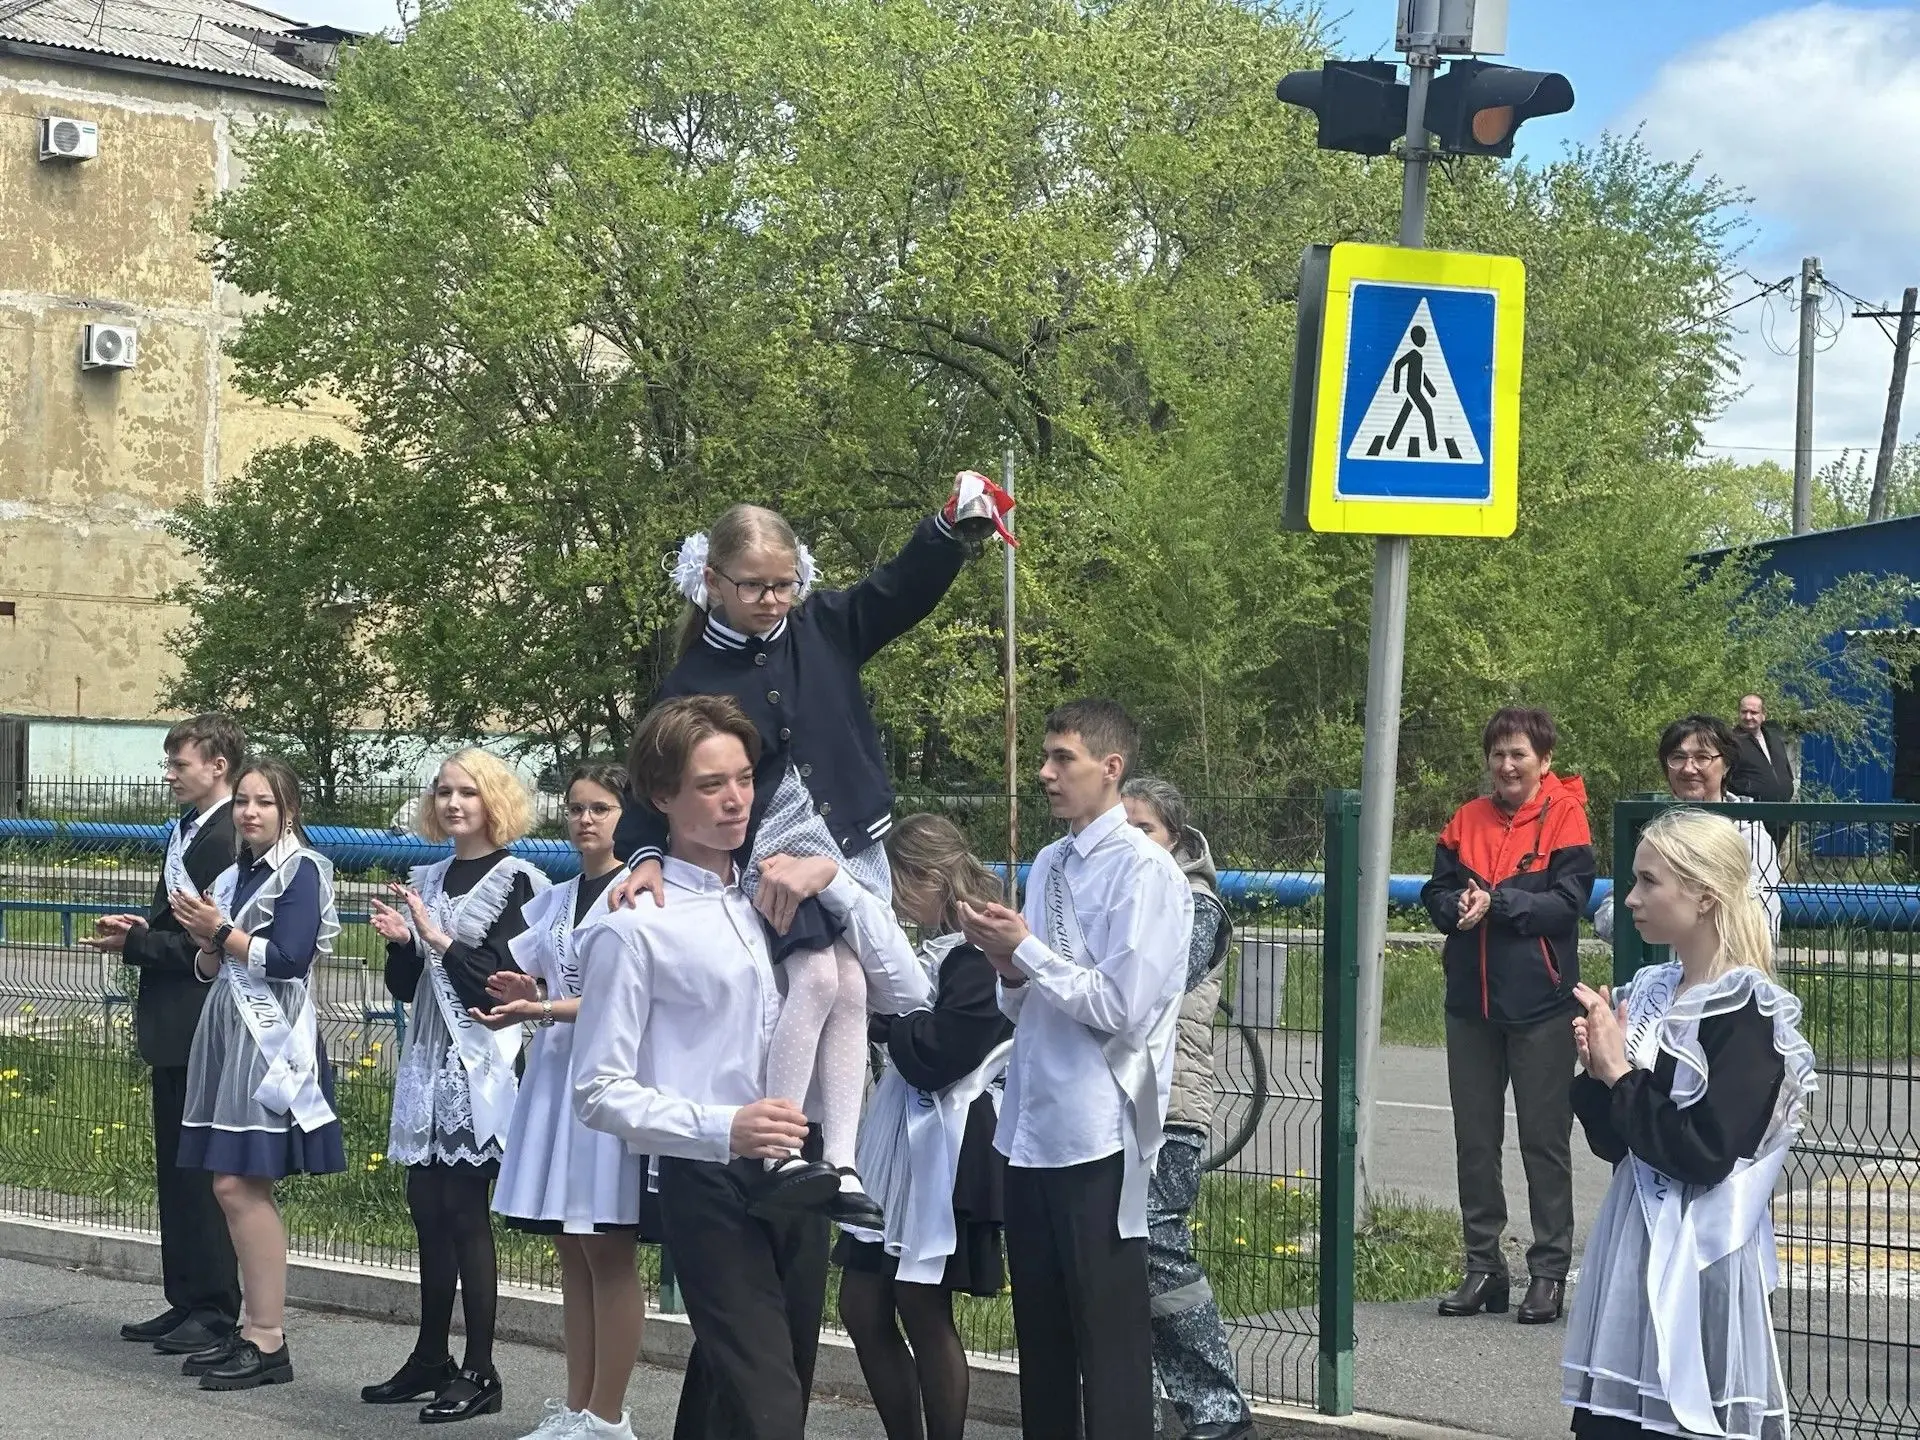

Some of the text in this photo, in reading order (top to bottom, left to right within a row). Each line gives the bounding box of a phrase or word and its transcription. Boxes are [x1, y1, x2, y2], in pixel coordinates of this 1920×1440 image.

[560, 963, 582, 998] 202
[244, 994, 282, 1029] 2026
[443, 991, 478, 1029] 2026
